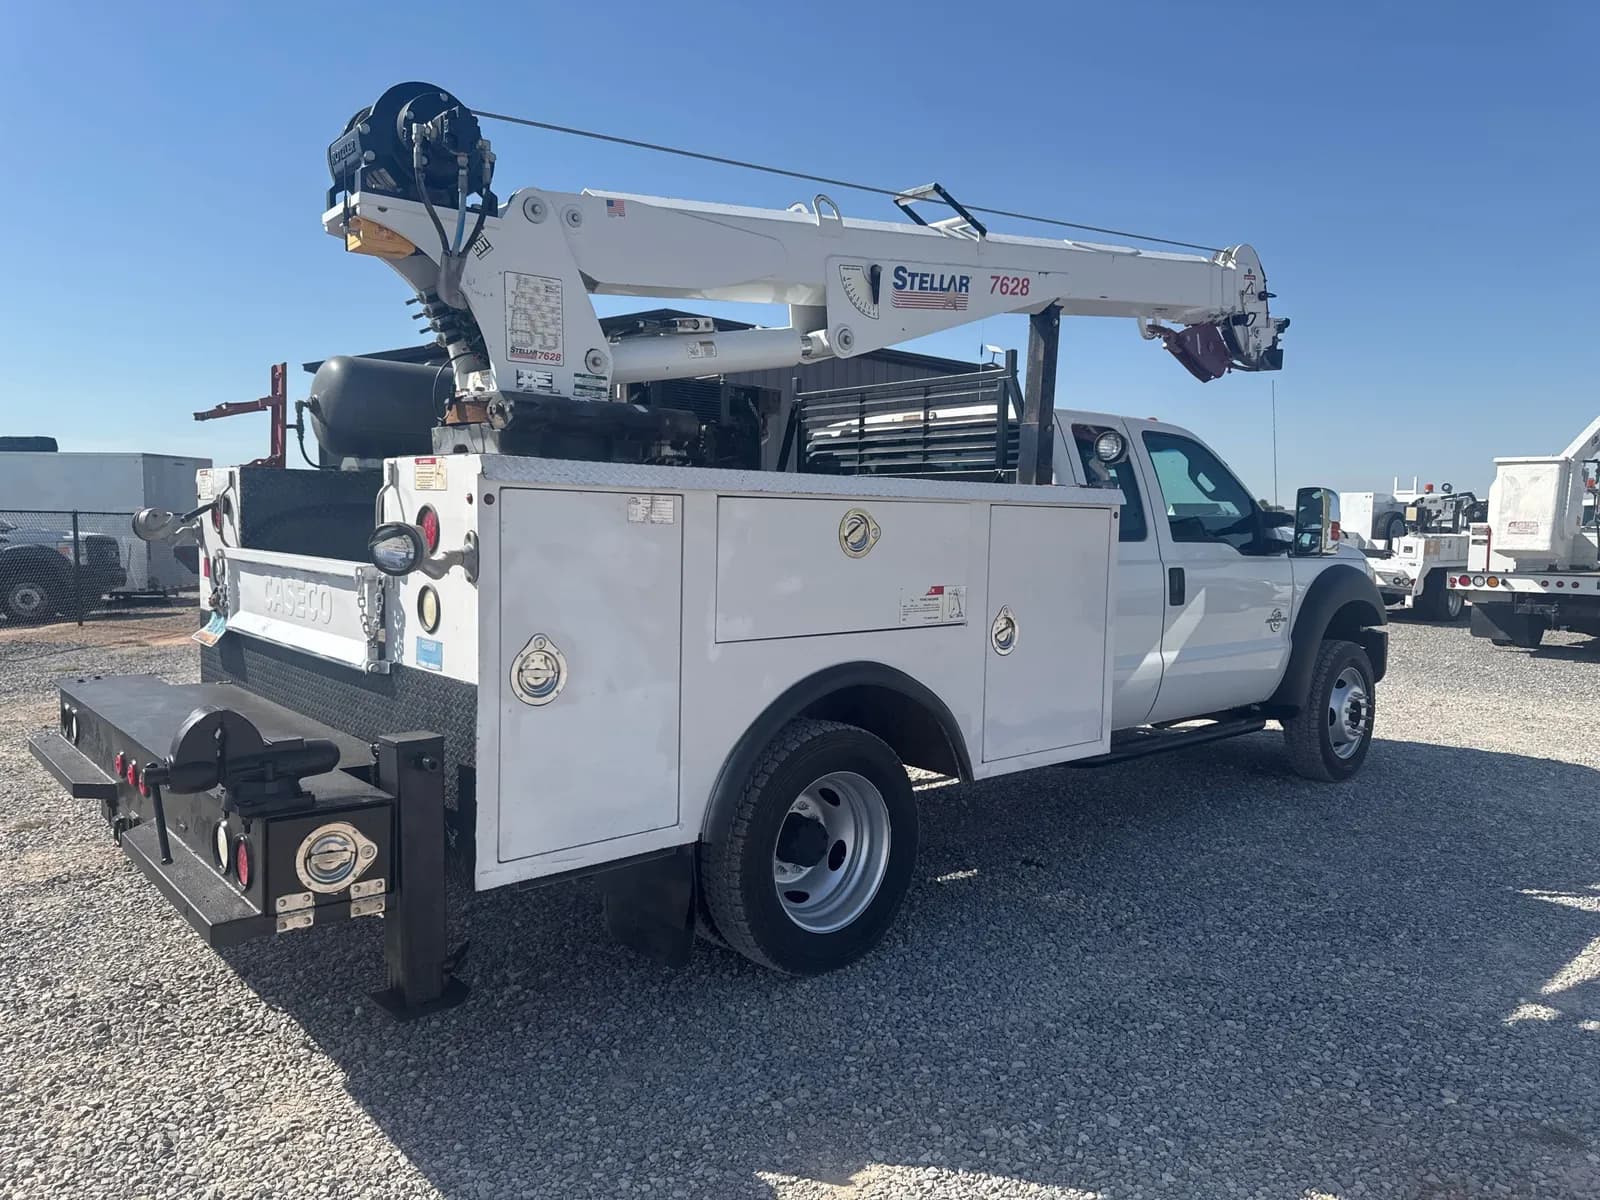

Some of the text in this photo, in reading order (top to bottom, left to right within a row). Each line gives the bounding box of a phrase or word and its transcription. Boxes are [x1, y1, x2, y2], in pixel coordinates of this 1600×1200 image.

[472, 237, 489, 255] CDT
[893, 266, 1030, 296] STELLAR 7628
[510, 346, 561, 361] STELLAR 7628
[265, 578, 332, 624] CASECO
